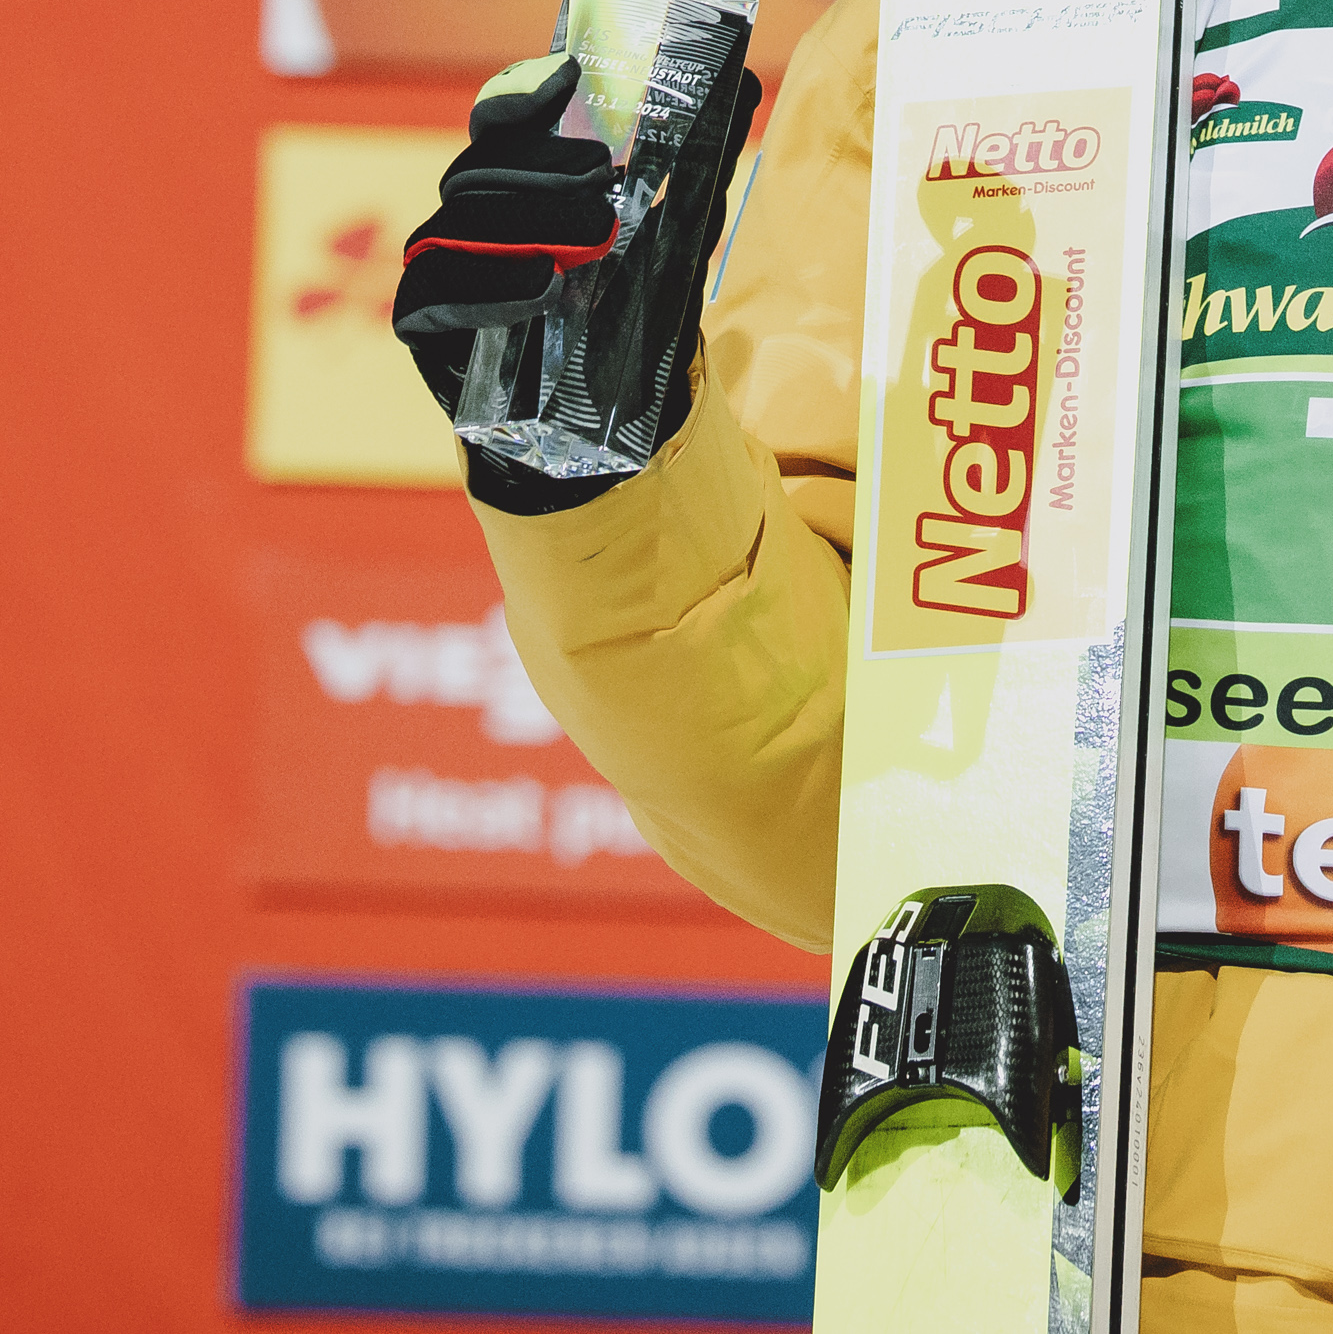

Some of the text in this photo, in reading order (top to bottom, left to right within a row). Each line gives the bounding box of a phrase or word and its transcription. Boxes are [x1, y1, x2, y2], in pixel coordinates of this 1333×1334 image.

[926, 120, 1101, 182] Netto
[973, 178, 1096, 199] Marken-Discount
[913, 245, 1042, 620] Netto
[1049, 246, 1086, 512] Marken-Discount
[853, 901, 923, 1079] FES
